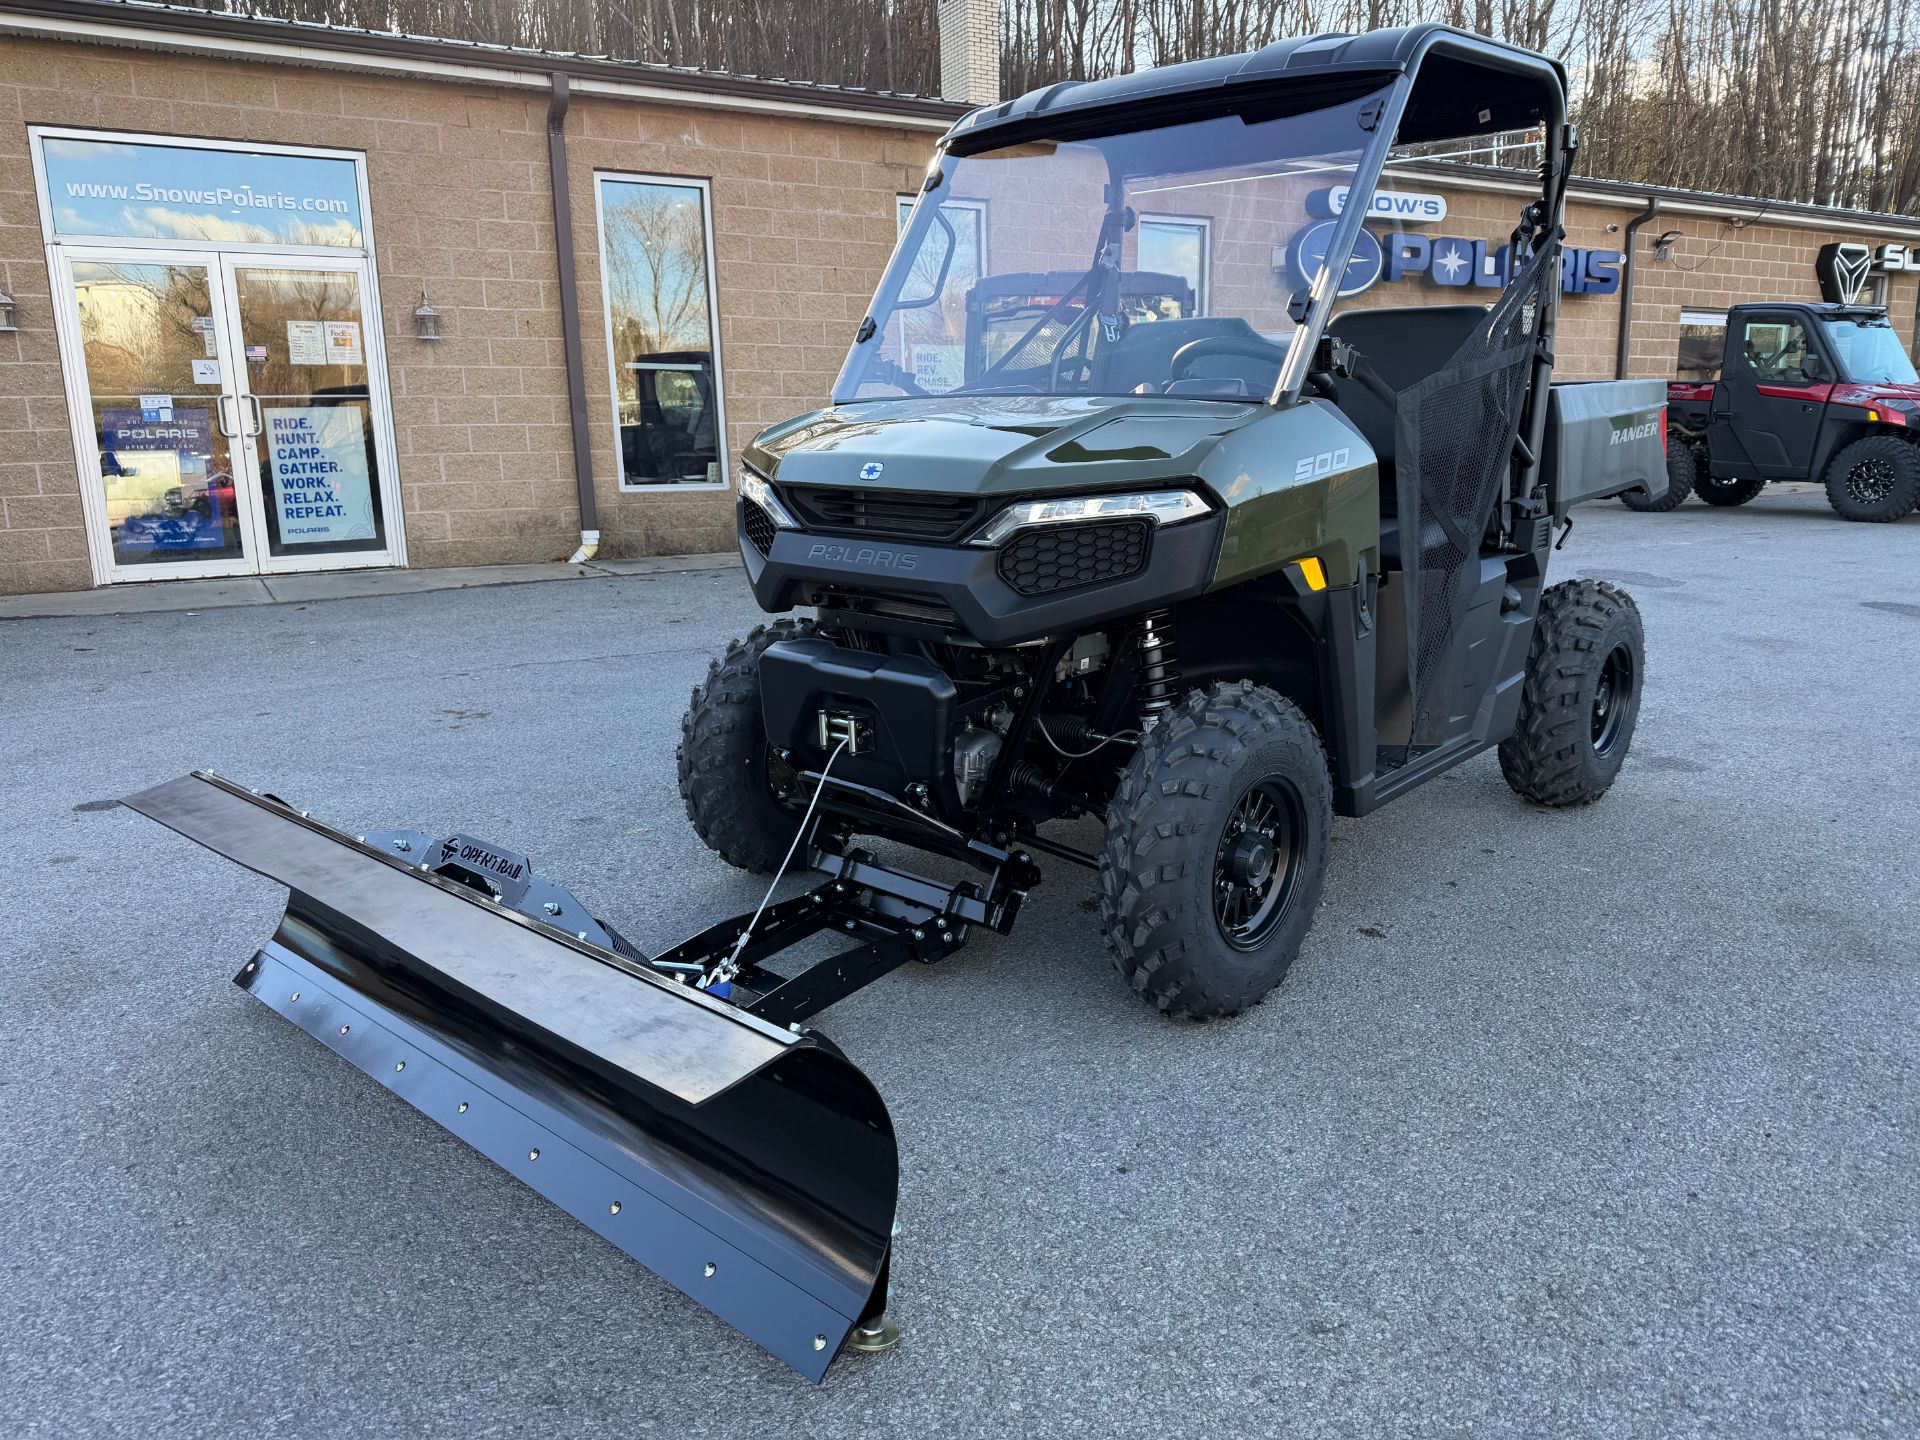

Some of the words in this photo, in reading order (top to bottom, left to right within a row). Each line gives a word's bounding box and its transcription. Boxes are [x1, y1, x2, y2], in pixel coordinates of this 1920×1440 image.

[66, 183, 349, 214] www.SnowsPolaris.com
[1337, 193, 1440, 216] SOW'S
[916, 352, 942, 363] RIDE.
[917, 364, 939, 375] REV.
[917, 376, 953, 387] CHASE.
[273, 417, 313, 430] RIDE.
[117, 428, 199, 439] POLARIS
[275, 432, 320, 445] HUNT.
[1609, 421, 1659, 446] RANGER
[277, 447, 325, 460] CAMP.
[279, 461, 343, 475] GATHER.
[1294, 447, 1350, 482] 500
[281, 476, 331, 490] WORK.
[283, 491, 339, 505] RELAX.
[285, 505, 347, 519] REPEAT.
[287, 526, 331, 535] POLARIS
[807, 543, 920, 571] POLARIS
